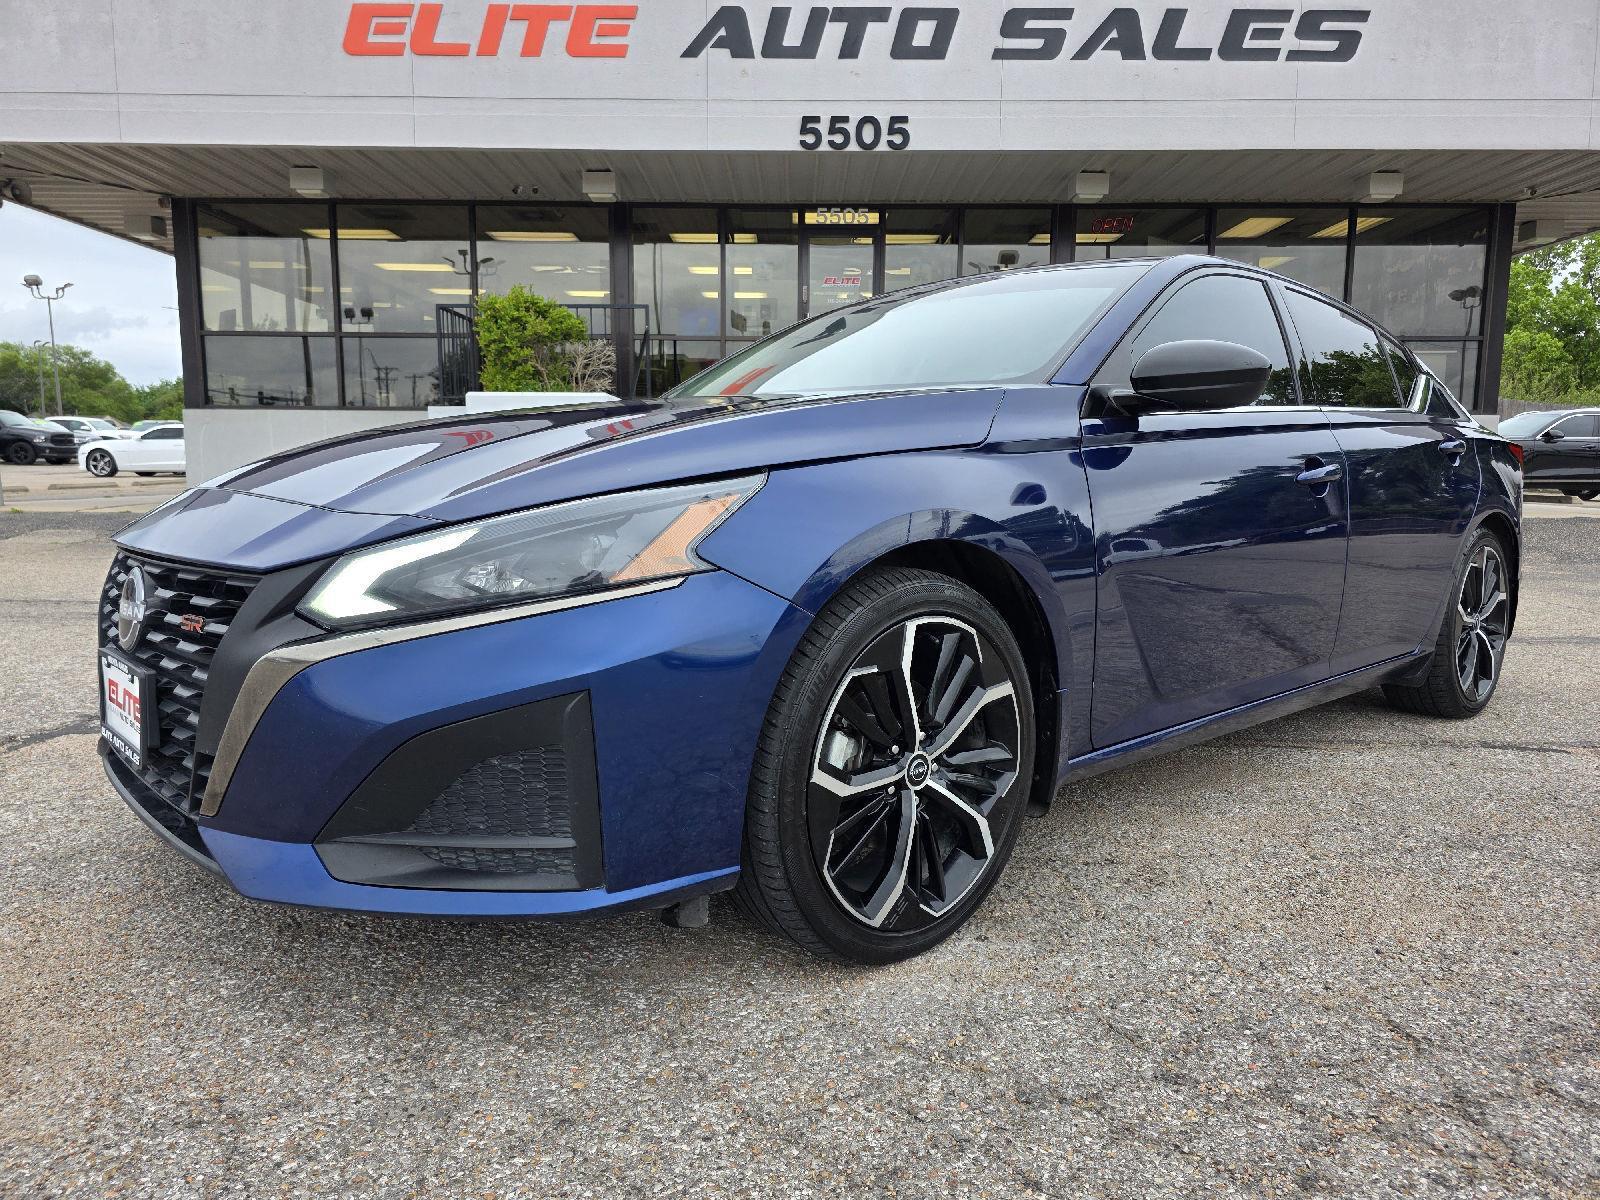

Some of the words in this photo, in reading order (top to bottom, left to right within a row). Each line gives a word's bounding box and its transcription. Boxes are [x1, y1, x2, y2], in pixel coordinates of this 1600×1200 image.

[343, 3, 637, 57] ELITE
[680, 6, 959, 59] AUTO
[992, 8, 1371, 62] SALES
[800, 116, 910, 149] 5505
[815, 207, 869, 224] 5505
[1091, 216, 1135, 233] OPEN
[823, 276, 861, 285] ELITE
[180, 613, 205, 633] SR
[108, 678, 141, 725] ELITE
